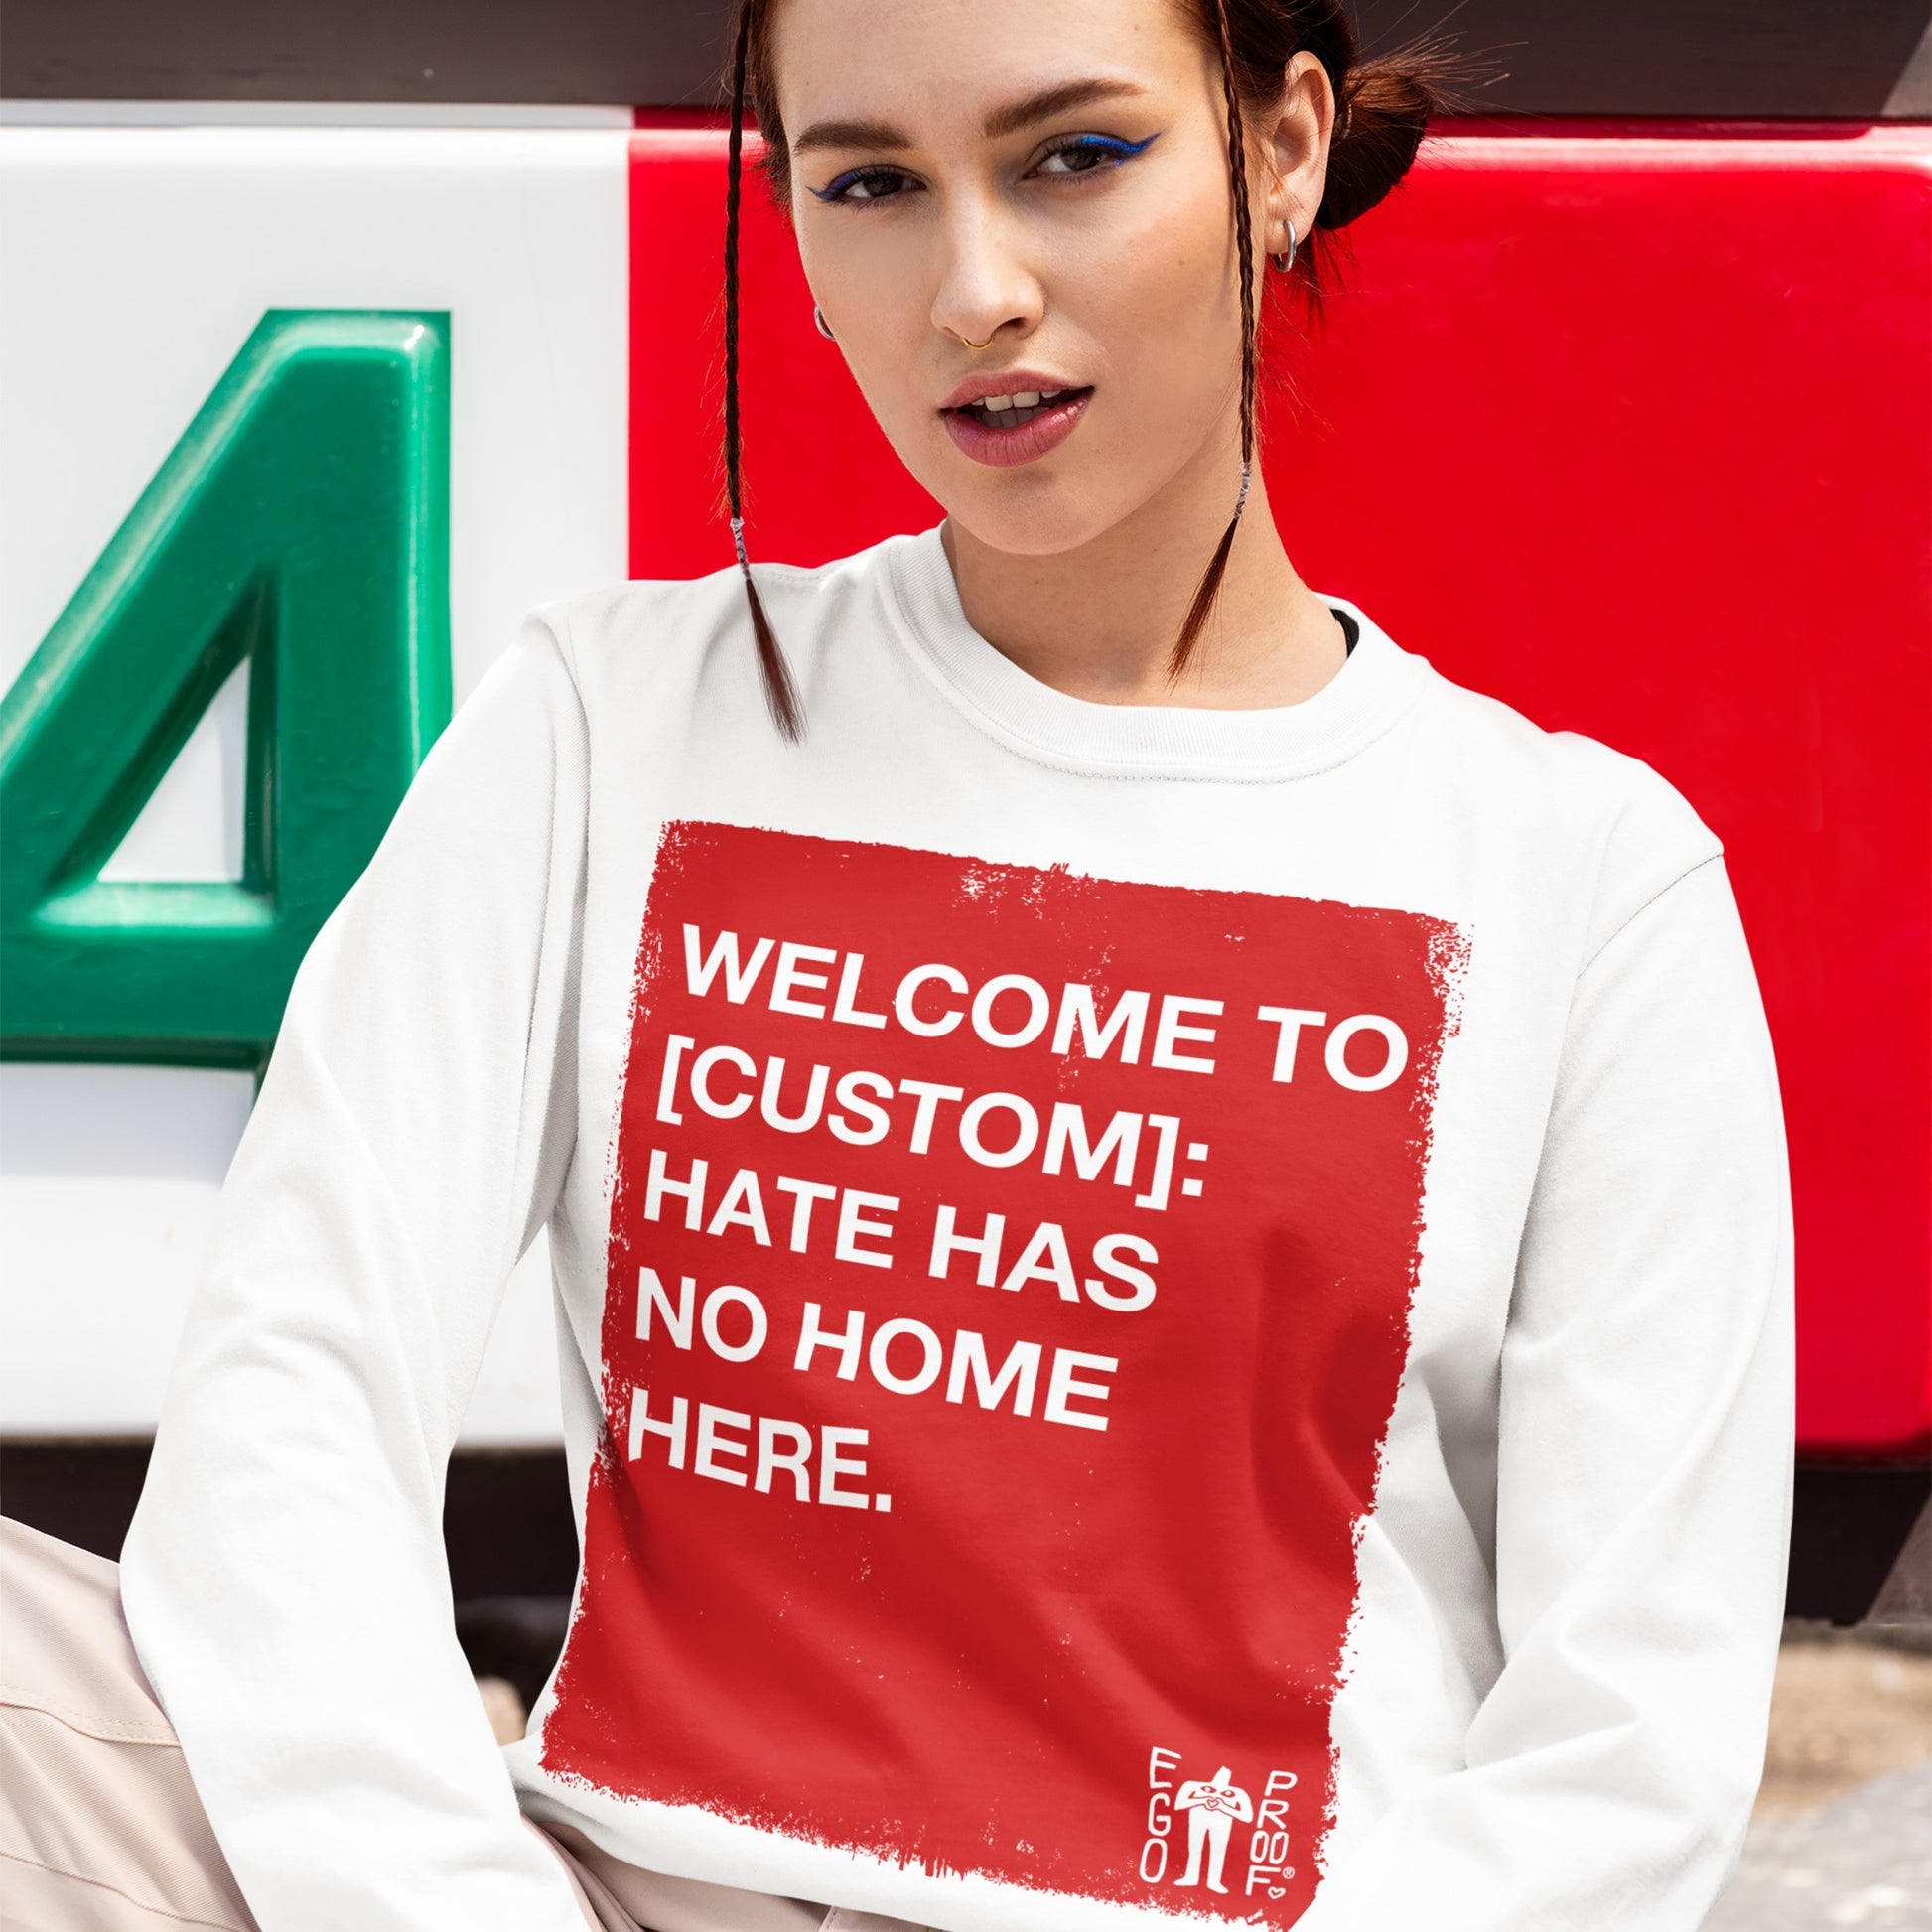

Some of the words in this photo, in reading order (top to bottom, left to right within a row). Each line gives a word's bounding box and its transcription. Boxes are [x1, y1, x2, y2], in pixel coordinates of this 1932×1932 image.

[0, 309, 453, 1107] 4
[683, 923, 1225, 1075] WELCOME
[1257, 1005, 1409, 1092] TO
[656, 1034, 1209, 1211] [CUSTOM]:
[643, 1149, 900, 1269] HATE
[928, 1204, 1159, 1312] HAS
[635, 1266, 768, 1363] NO
[793, 1301, 1119, 1432] HOME
[628, 1386, 892, 1513] HERE.
[1139, 1746, 1182, 1884] EGO
